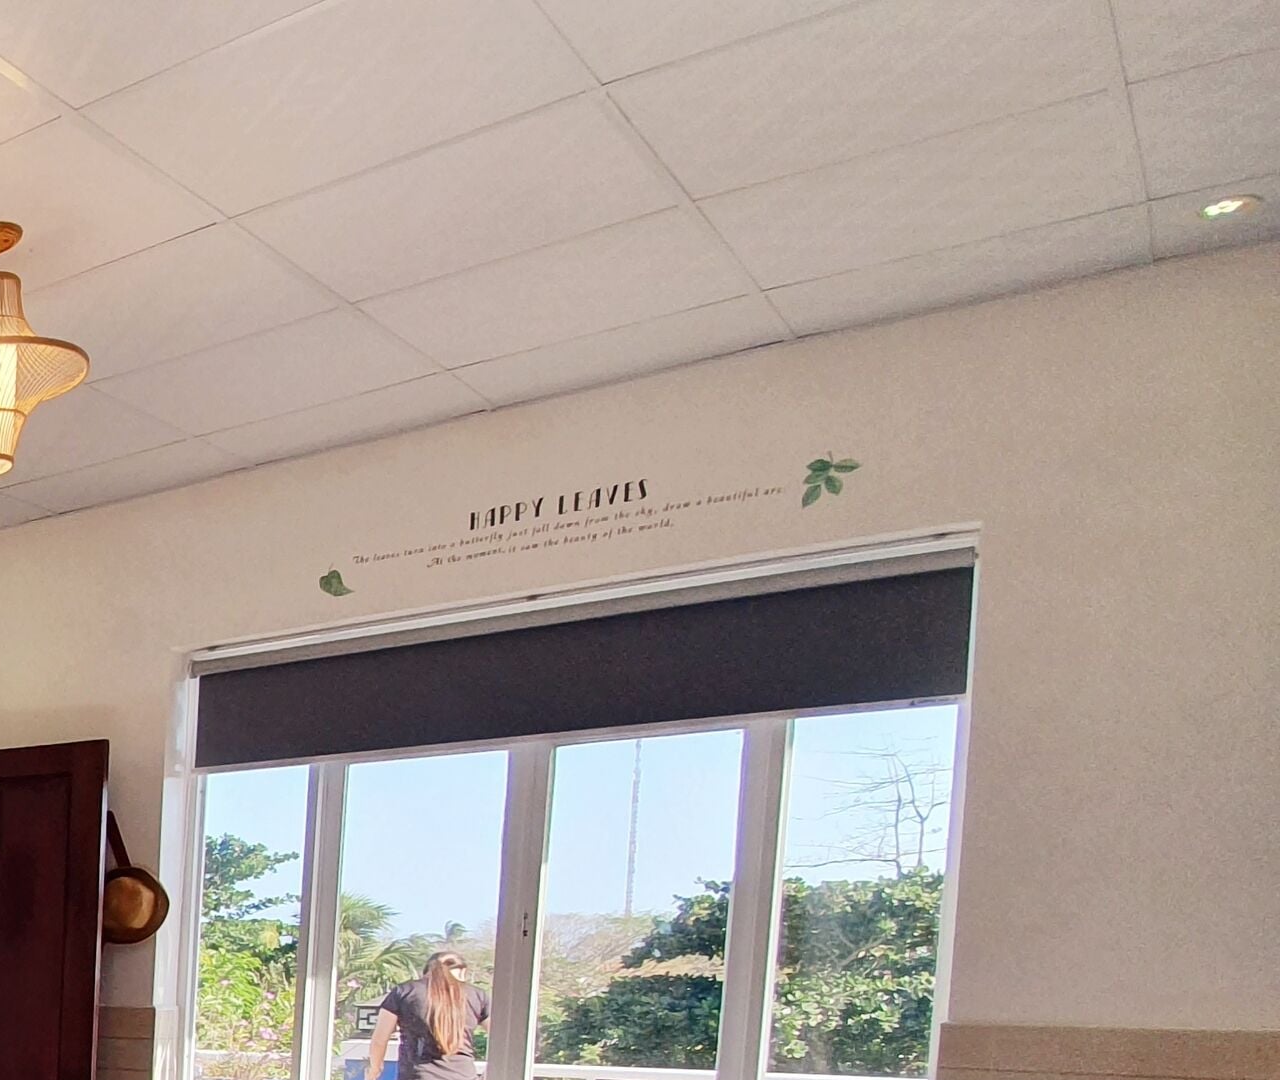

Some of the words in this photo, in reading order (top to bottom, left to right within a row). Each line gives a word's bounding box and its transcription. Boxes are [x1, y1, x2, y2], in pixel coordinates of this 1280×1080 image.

[352, 555, 369, 564] The
[373, 551, 400, 561] leaves
[403, 547, 425, 556] turn
[428, 543, 447, 552] into
[459, 532, 503, 547] butterfly
[506, 529, 528, 541] just
[531, 523, 550, 537] fall
[553, 520, 580, 530] down
[584, 516, 609, 528] from
[614, 511, 630, 520] the
[662, 502, 690, 512] draw
[706, 487, 759, 504] beautiful
[469, 497, 544, 531] HAPPY
[557, 478, 647, 515] LEAVES
[426, 557, 443, 568] At
[447, 554, 462, 563] the
[520, 543, 539, 551] saw
[543, 538, 559, 546] the
[563, 531, 598, 544] beauty
[601, 529, 612, 539] of
[617, 525, 633, 535] the
